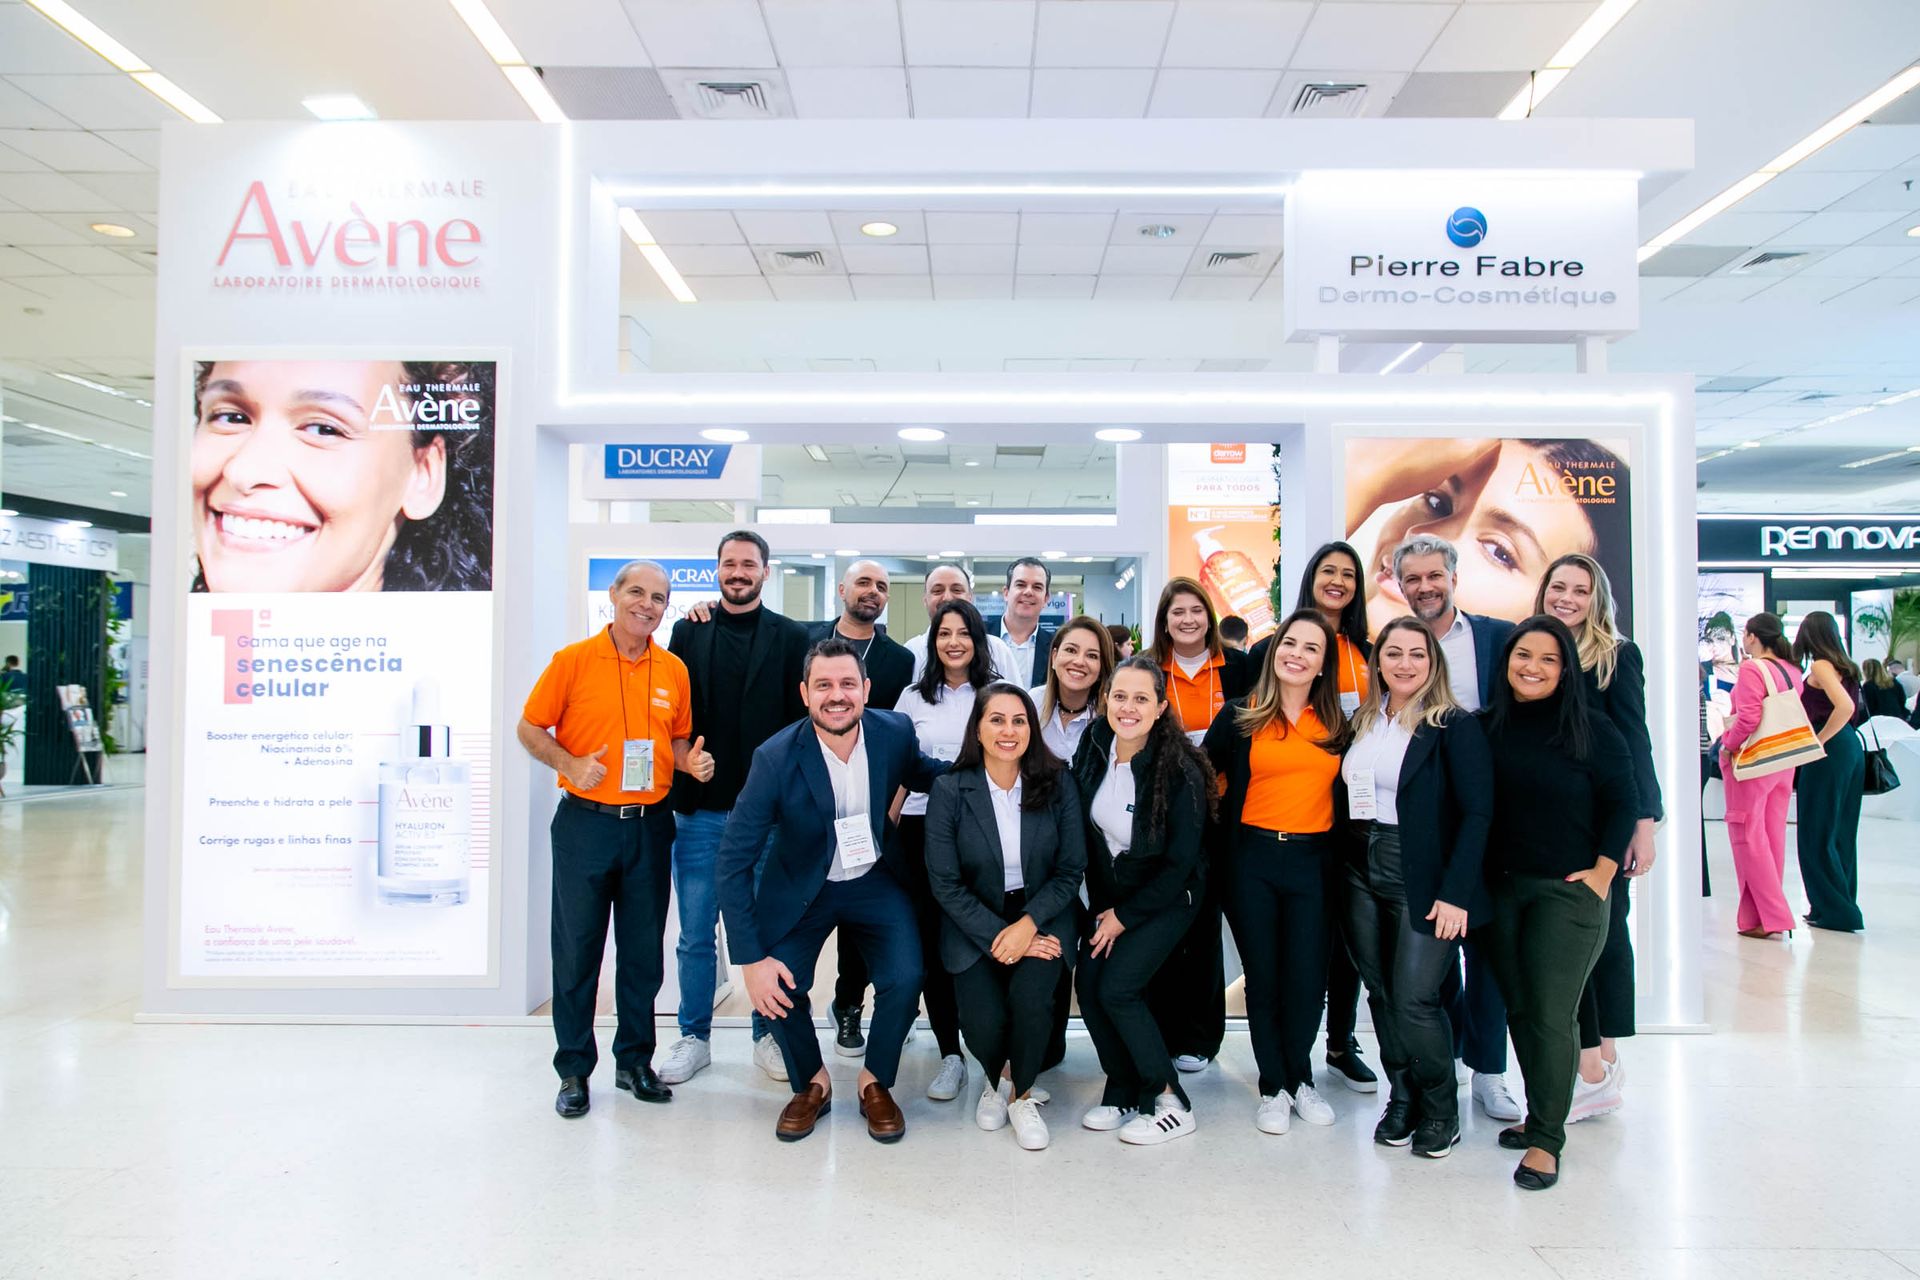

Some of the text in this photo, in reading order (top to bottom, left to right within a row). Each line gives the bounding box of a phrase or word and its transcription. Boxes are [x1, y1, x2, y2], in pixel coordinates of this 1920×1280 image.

[353, 180, 484, 198] HERMALE
[215, 180, 481, 267] Avène
[1350, 254, 1584, 277] Pierre Fabre
[214, 276, 481, 289] LABORATOIRE DERMATOLOGIQUE
[1319, 285, 1618, 308] Dermo-Cosmétique
[399, 383, 481, 392] EAU THERMALE
[369, 383, 481, 422] Avène
[618, 448, 714, 468] DUCRAY
[1565, 461, 1616, 469] THERMALE
[1196, 484, 1260, 492] PARA TODOS
[1514, 462, 1616, 497] Avène
[237, 635, 387, 652] Gama que age na
[237, 651, 402, 672] senescência
[236, 678, 329, 697] celular
[207, 731, 248, 740] Booster
[260, 744, 331, 753] Niacinamida
[294, 757, 353, 766] Adenosina
[209, 797, 260, 807] Preenche
[273, 796, 314, 807] hidrata
[329, 796, 352, 809] pele
[397, 787, 454, 809] Avène
[395, 822, 446, 830] HYALURON
[199, 835, 240, 848] Corrige
[243, 838, 275, 847] rugas
[288, 834, 321, 845] linhas
[325, 833, 352, 845] finas
